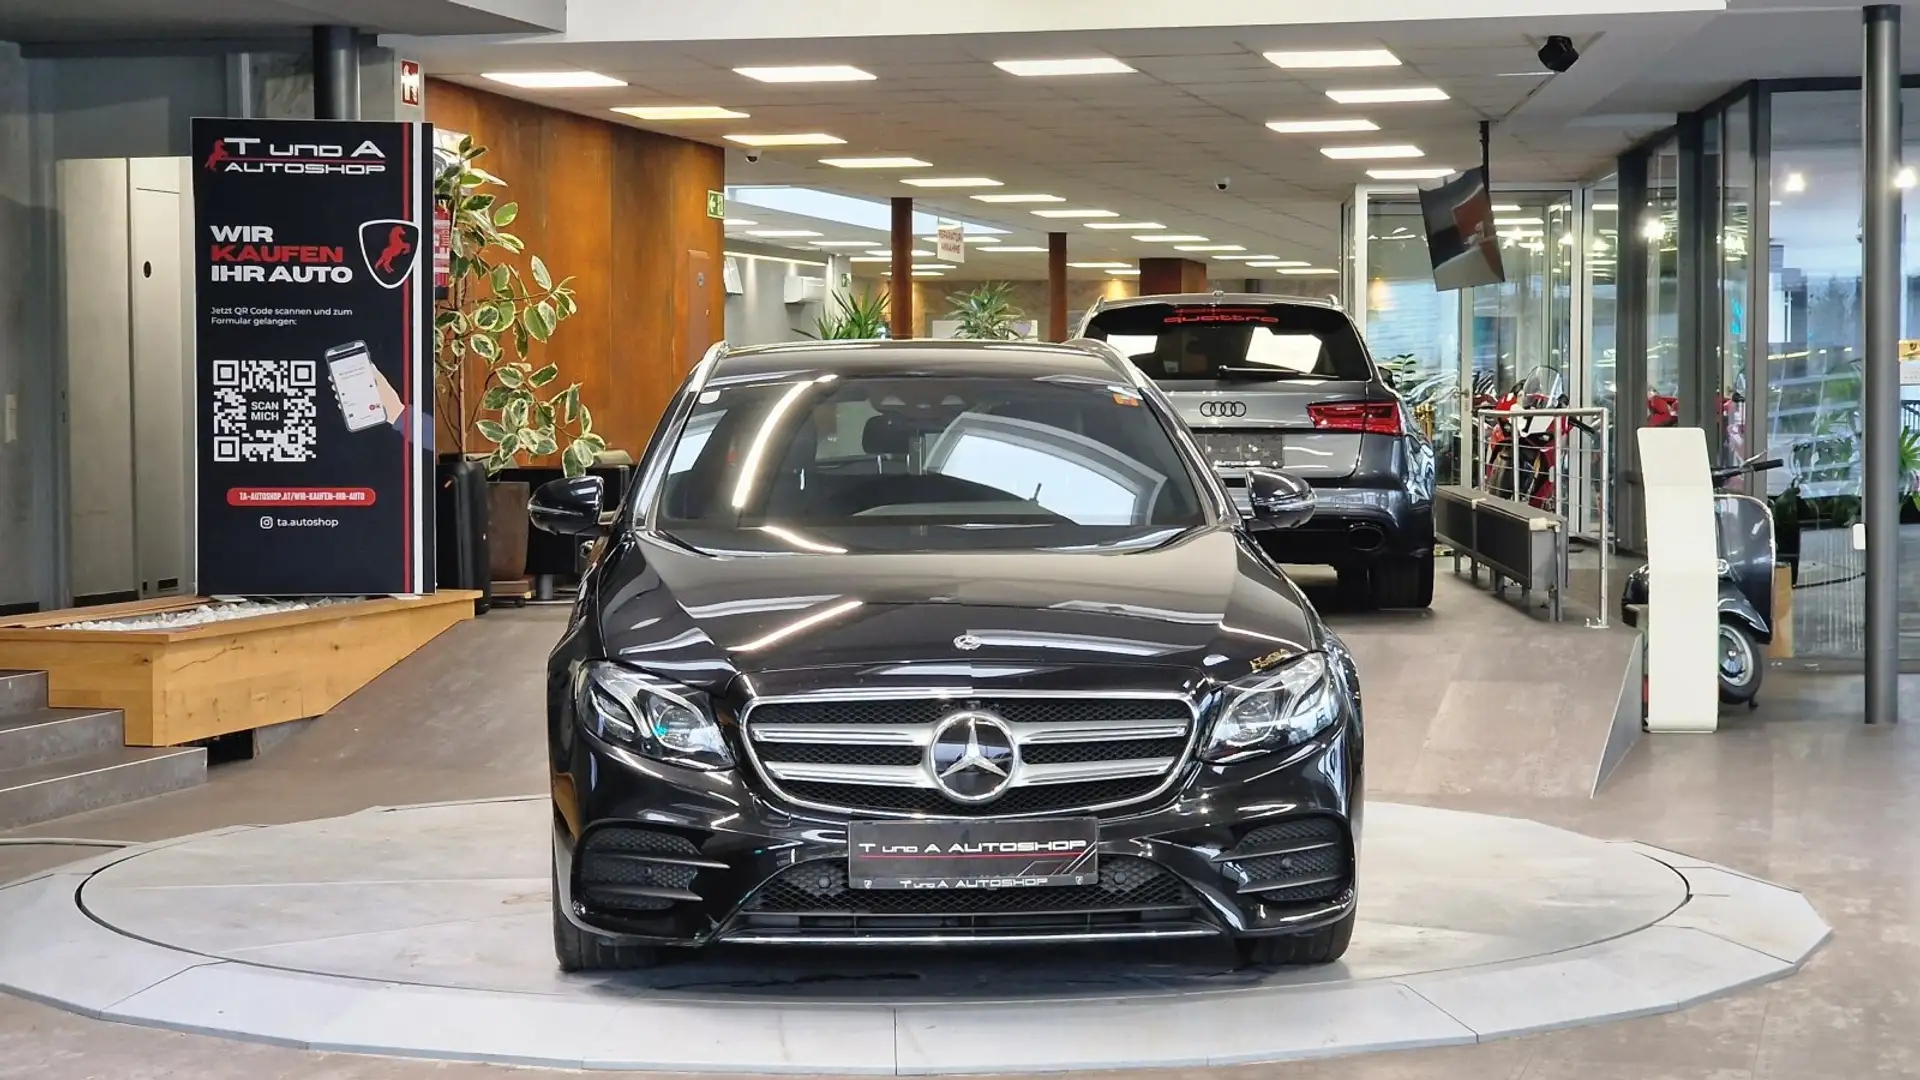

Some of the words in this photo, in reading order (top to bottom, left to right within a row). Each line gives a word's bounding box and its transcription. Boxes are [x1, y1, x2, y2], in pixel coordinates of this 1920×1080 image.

[224, 138, 261, 155] T
[350, 140, 386, 159] A
[224, 163, 387, 175] AUTOSHOP
[210, 225, 274, 242] WIR
[210, 245, 344, 263] KAUFEN
[211, 265, 265, 282] IHR
[270, 265, 353, 283] AUTO
[211, 306, 233, 316] Jetzt
[234, 306, 249, 316] QR
[250, 306, 274, 316] Code
[274, 308, 313, 316] scannen
[314, 307, 332, 316] und
[333, 308, 353, 316] zum
[211, 316, 252, 326] Formular
[253, 316, 297, 327] gelangen:
[1163, 315, 1279, 324] quattro
[250, 401, 279, 411] SCAN
[250, 411, 279, 421] MICH
[276, 516, 339, 528] ta.autoshop
[858, 843, 876, 853] T
[924, 842, 941, 853] A
[948, 840, 1087, 853] AUTOSHOP
[900, 879, 912, 889] T
[938, 879, 949, 889] A
[955, 878, 1048, 888] AUTOSHOP
